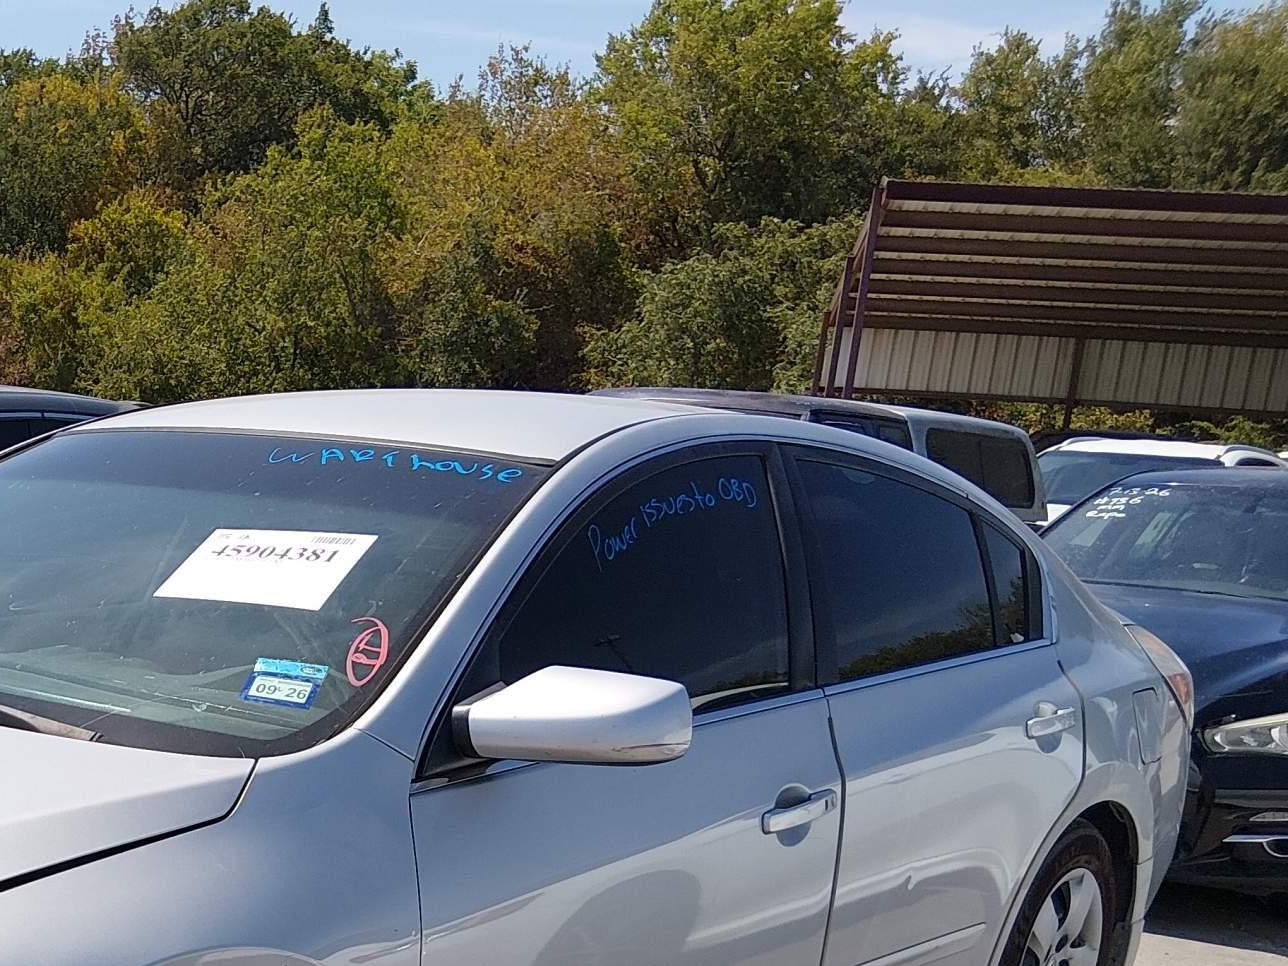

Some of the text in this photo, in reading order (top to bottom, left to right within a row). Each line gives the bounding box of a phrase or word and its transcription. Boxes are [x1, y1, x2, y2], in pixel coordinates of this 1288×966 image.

[587, 517, 638, 572] Power
[690, 481, 716, 509] to
[718, 478, 757, 508] OBD
[211, 544, 341, 564] 45904381
[255, 683, 308, 700] 09 26
